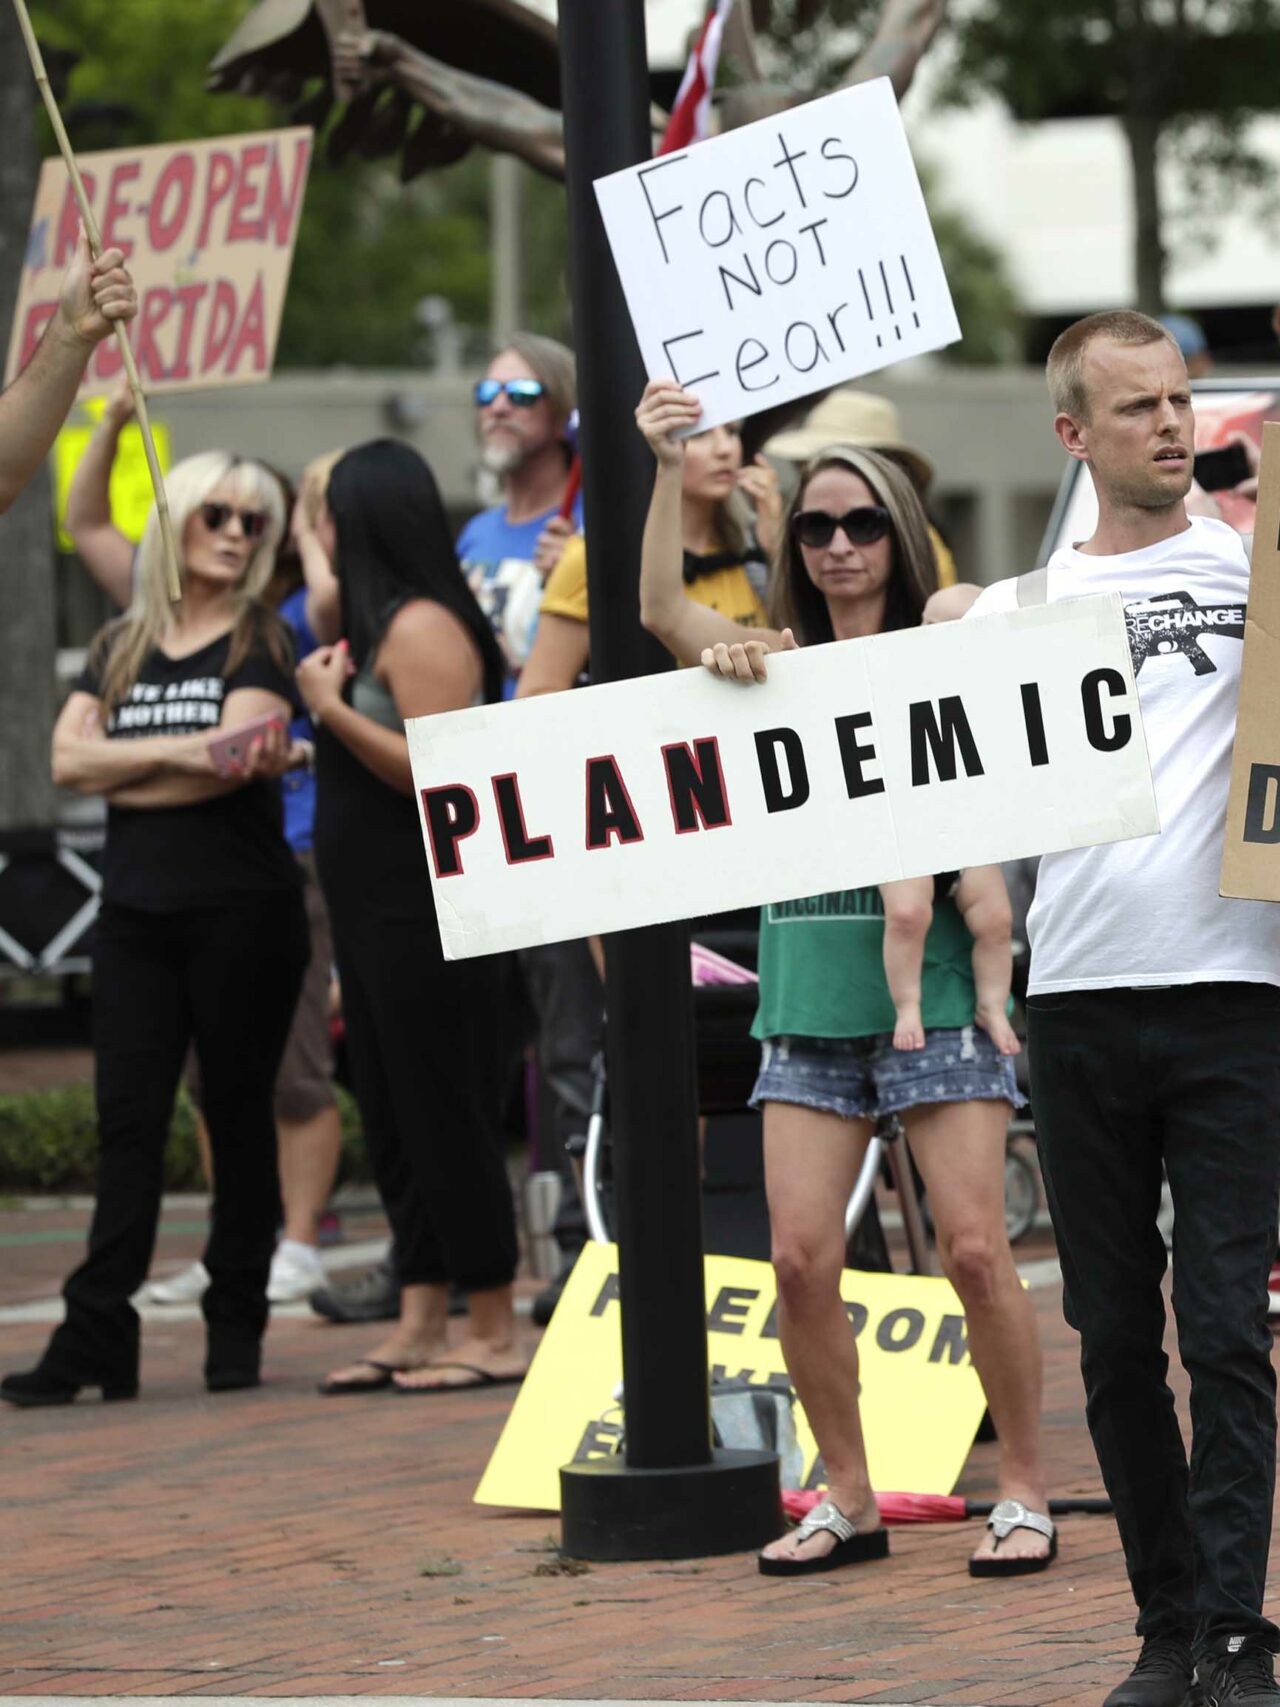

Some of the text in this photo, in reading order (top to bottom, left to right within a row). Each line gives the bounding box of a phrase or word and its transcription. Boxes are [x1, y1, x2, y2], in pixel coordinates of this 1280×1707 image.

[54, 138, 311, 269] RE-OPEN
[637, 133, 859, 264] Facts
[662, 254, 921, 392] Fear!!!
[718, 218, 828, 311] NOT
[420, 667, 1133, 878] PLANDEMIC
